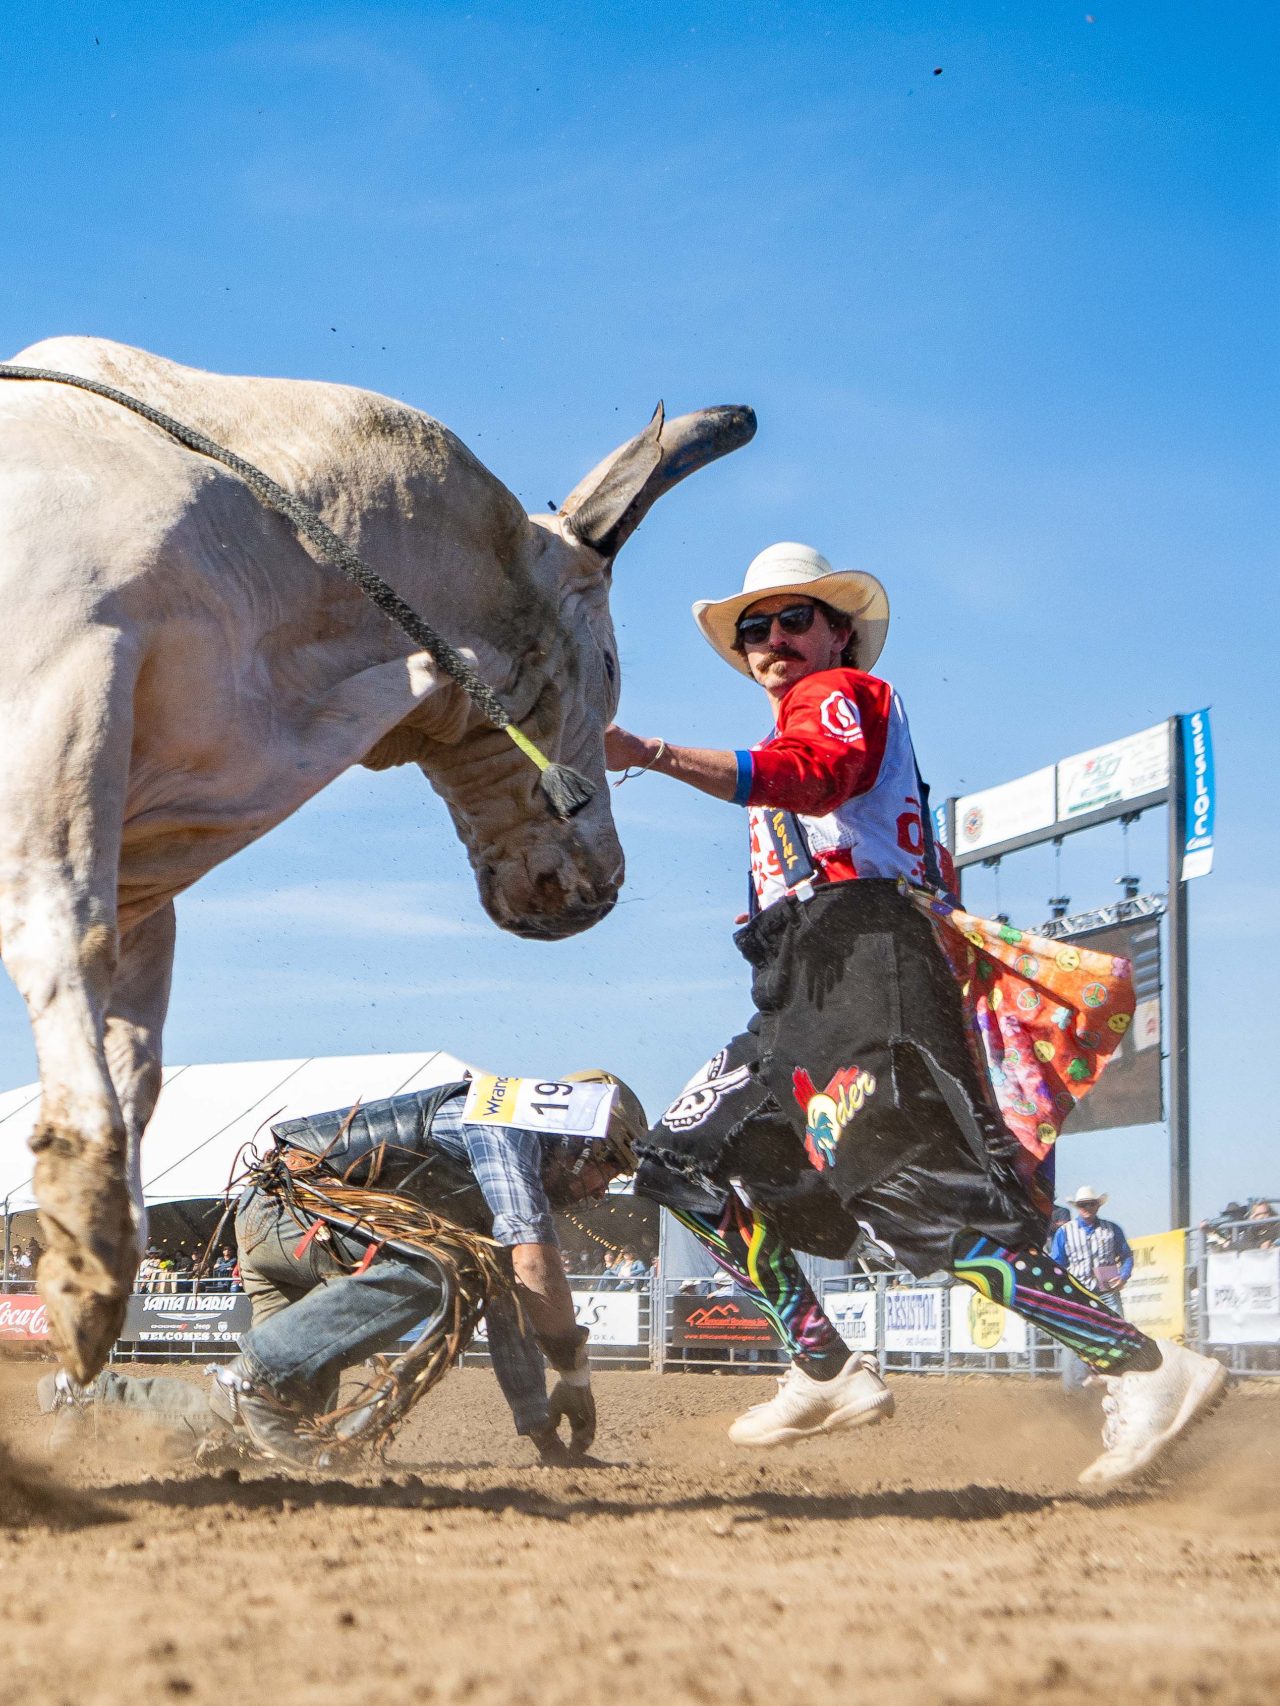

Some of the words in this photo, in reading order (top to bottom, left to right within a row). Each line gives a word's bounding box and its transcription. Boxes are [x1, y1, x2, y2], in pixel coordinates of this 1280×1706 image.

[1190, 712, 1210, 836] SESLOC
[530, 1082, 573, 1115] 19
[143, 1295, 185, 1311] SANTA
[186, 1295, 237, 1311] MARIA
[886, 1294, 937, 1331] RESISTOL
[139, 1332, 210, 1341] WELCOMES
[212, 1332, 242, 1341] YOU
